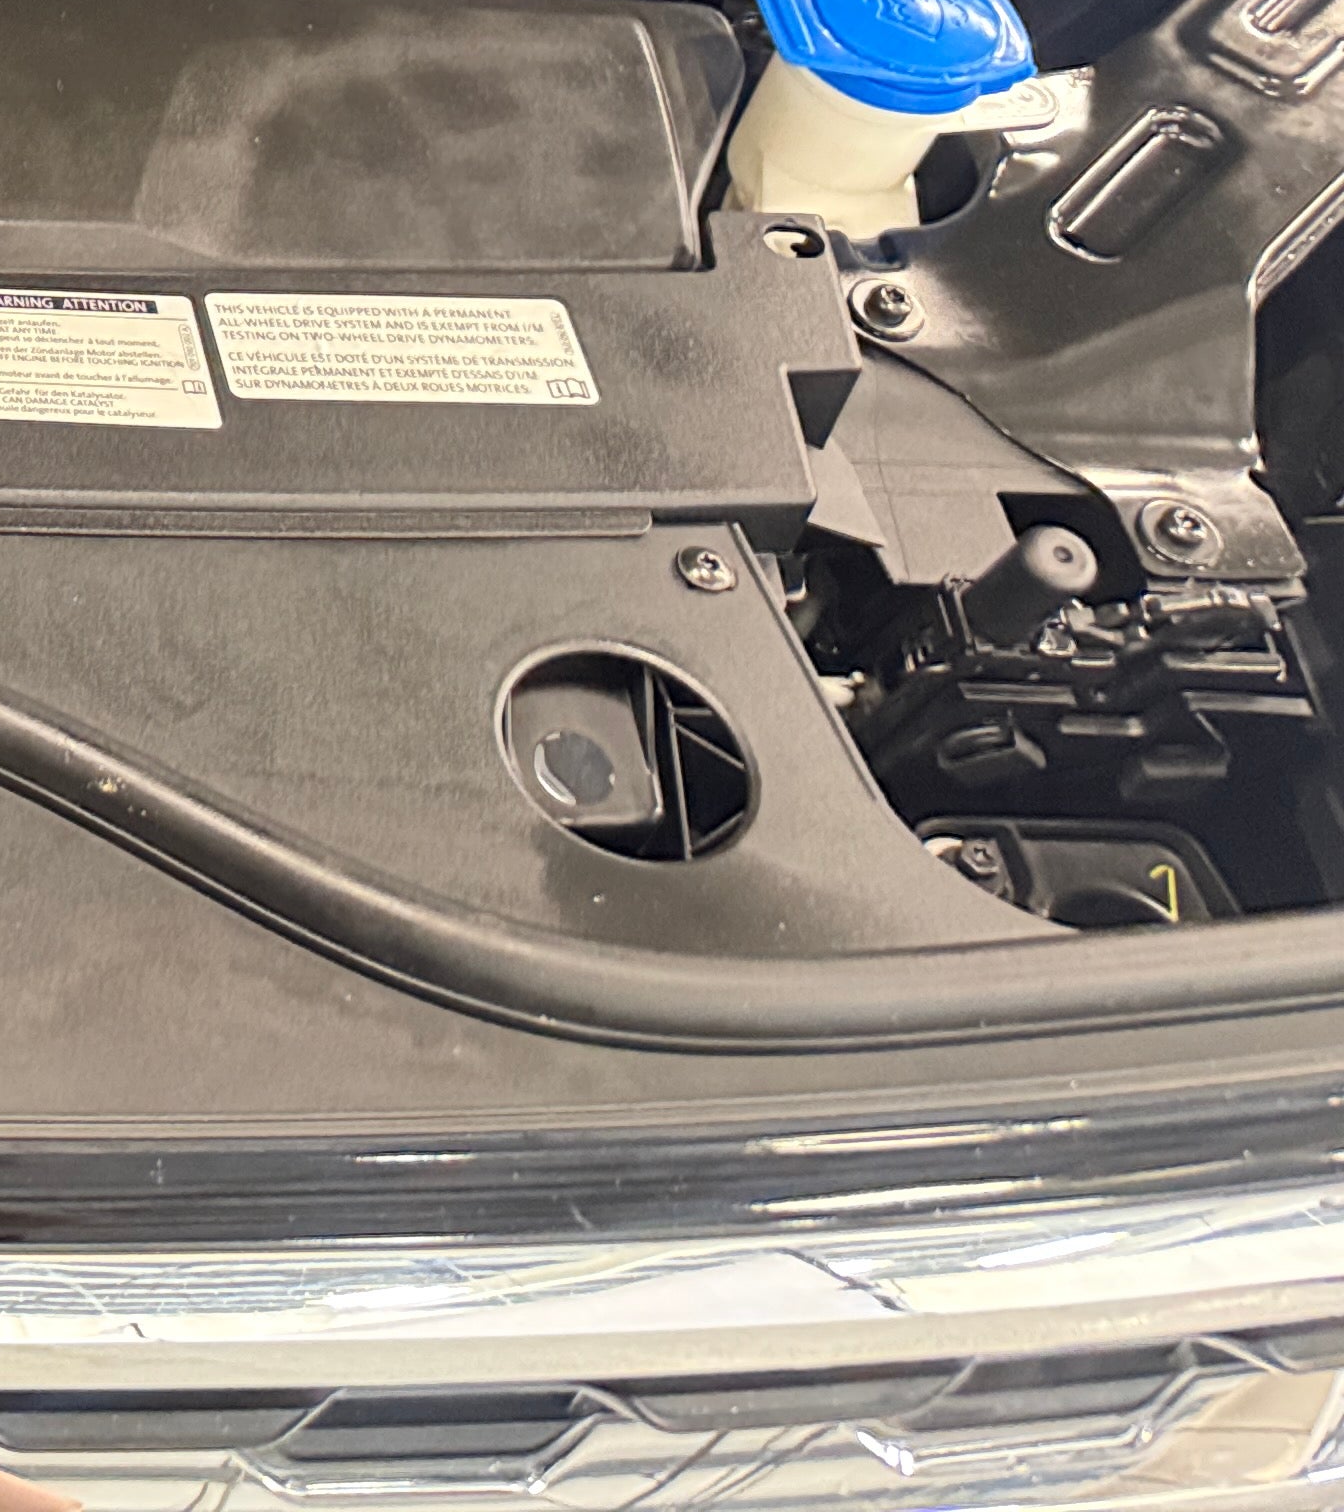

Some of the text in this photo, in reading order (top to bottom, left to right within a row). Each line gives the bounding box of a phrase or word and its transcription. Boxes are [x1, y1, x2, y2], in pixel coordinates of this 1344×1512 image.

[62, 298, 148, 313] ATTENTION
[214, 303, 512, 320] THIS VEHICLE IS EQUIPPED WITH A PERMANENT
[292, 319, 332, 330] DRIVE
[333, 320, 382, 330] SYSTEM
[385, 320, 414, 331] AND
[416, 322, 429, 331] IS
[430, 322, 480, 332] EXEMPT
[482, 323, 521, 333] FROM
[222, 330, 277, 341] TESTING
[278, 331, 301, 341] ON
[386, 333, 425, 344] DRIVE
[228, 350, 576, 369] CE VÉHICULE EST DOTÉ D'UN SYSTÈME DE TRANSMISSION
[232, 363, 299, 376] INTÉGRALE
[299, 366, 377, 378] PERMANENT
[379, 368, 393, 378] ET
[395, 367, 450, 379] EXEMPTÉ
[234, 378, 262, 389] SUR
[372, 378, 383, 391] À
[383, 381, 418, 392] DEUX
[420, 382, 466, 393] ROUES
